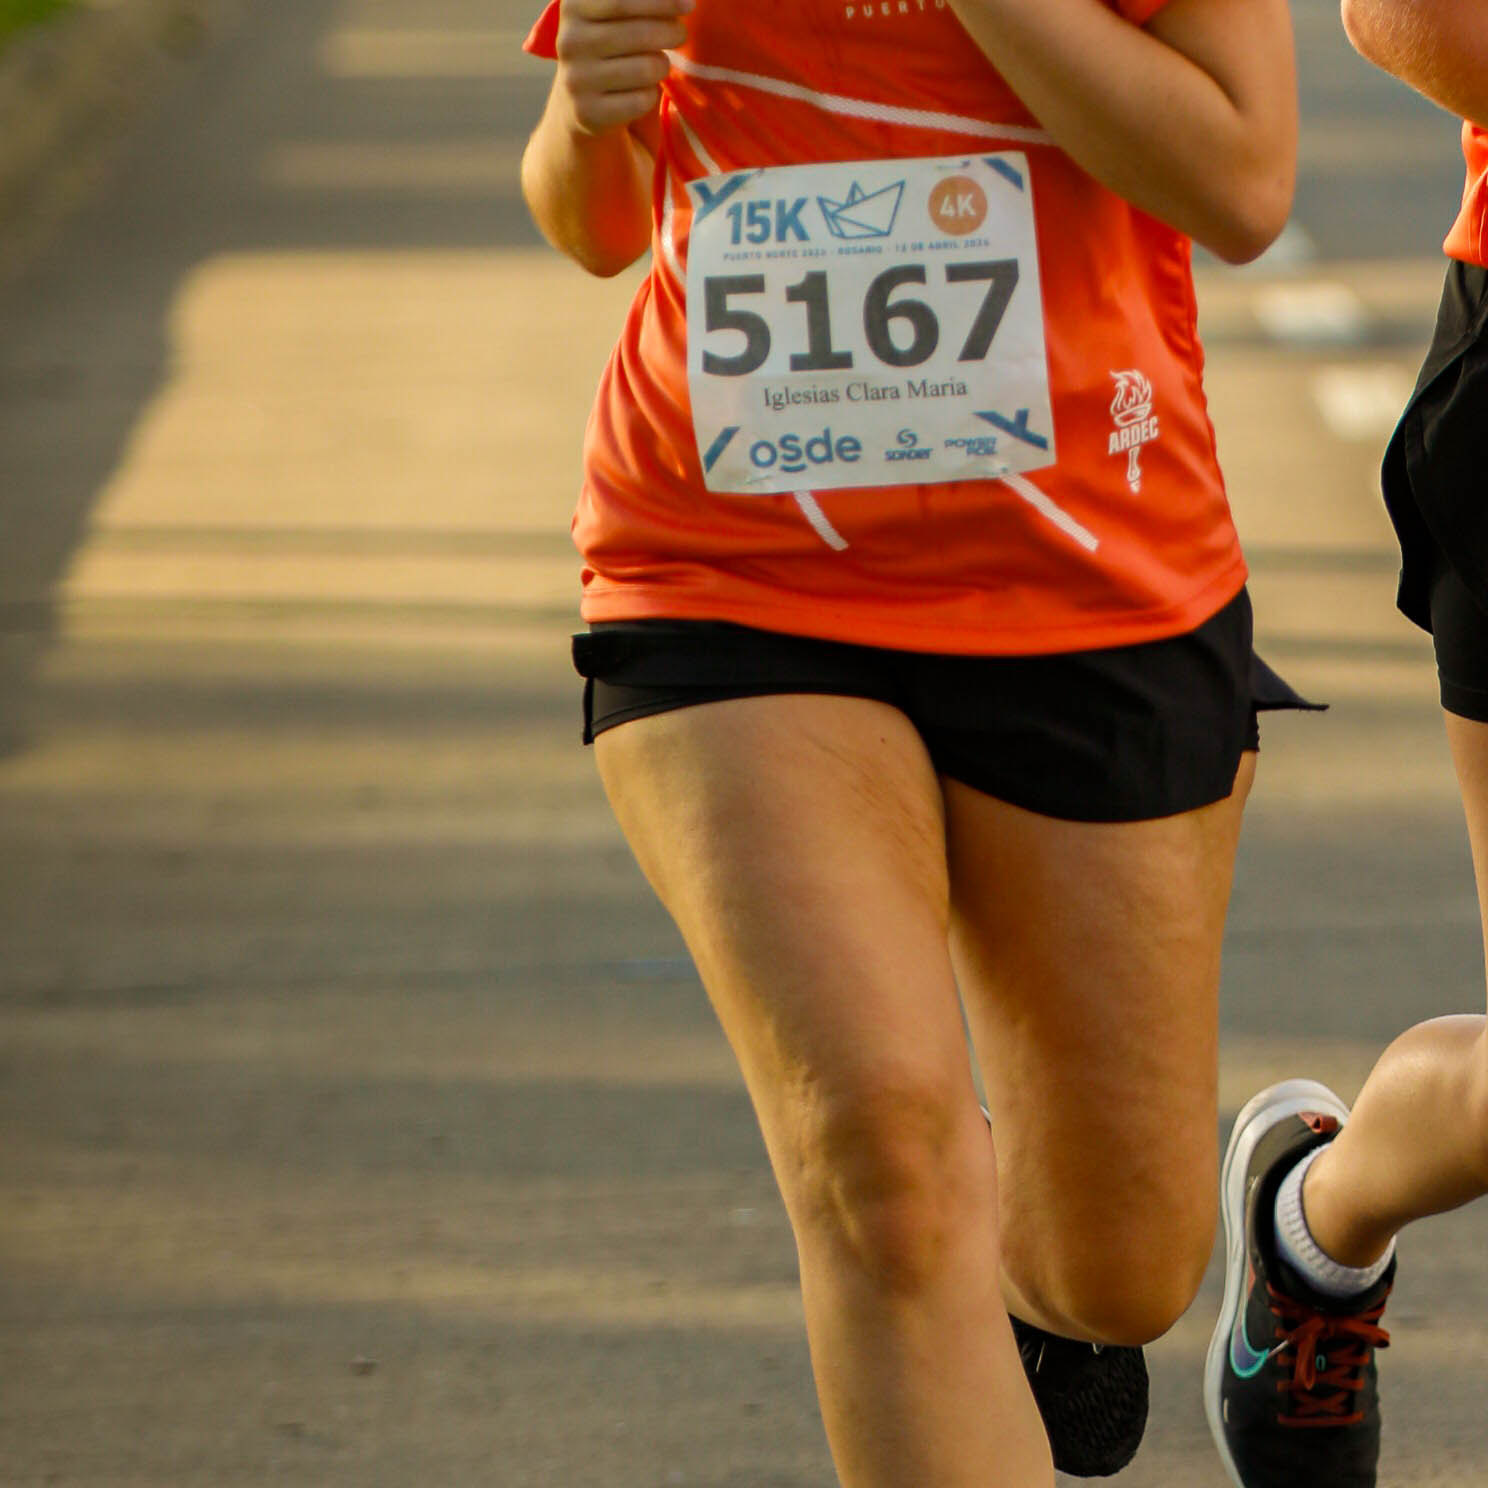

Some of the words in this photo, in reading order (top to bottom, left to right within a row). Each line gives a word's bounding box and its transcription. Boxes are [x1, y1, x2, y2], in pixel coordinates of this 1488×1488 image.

[725, 197, 811, 246] 15K
[938, 192, 976, 218] 4K
[702, 259, 1019, 376] 5167
[764, 385, 840, 411] Iglesias
[846, 381, 900, 403] Clara
[750, 426, 863, 472] osde
[1108, 415, 1160, 456] ARDEC
